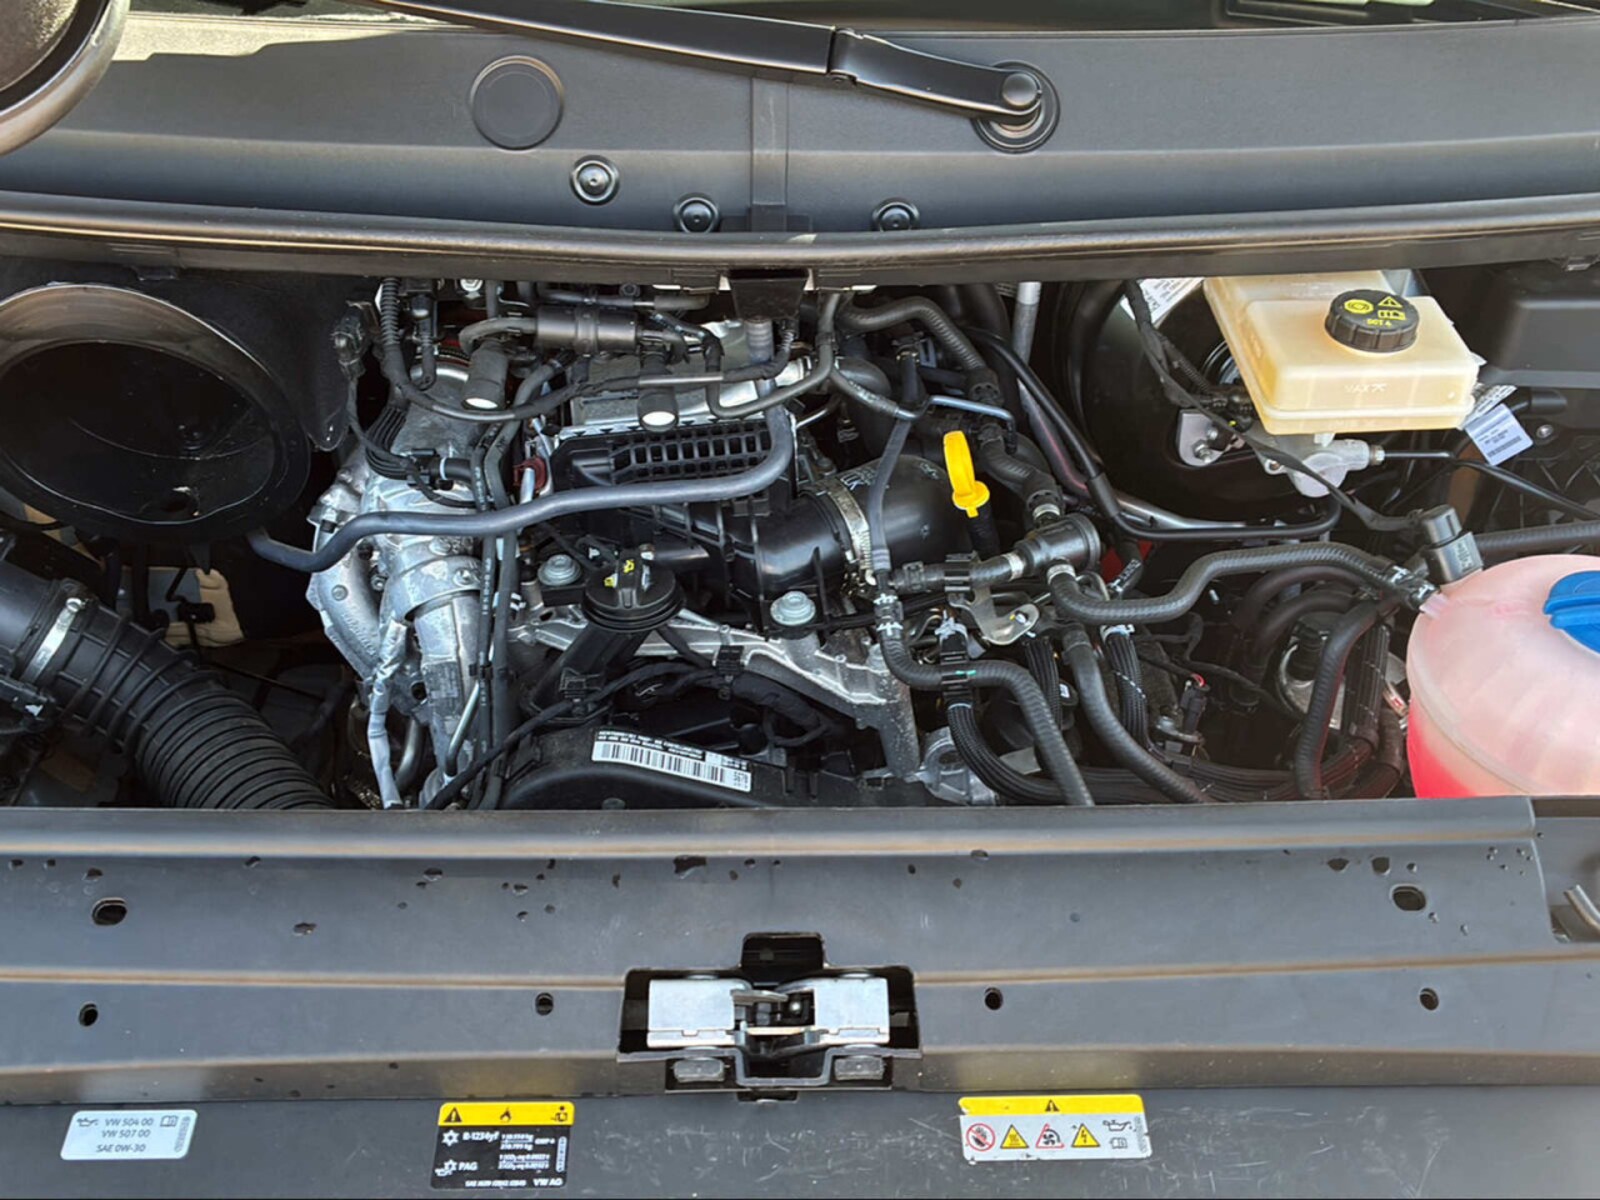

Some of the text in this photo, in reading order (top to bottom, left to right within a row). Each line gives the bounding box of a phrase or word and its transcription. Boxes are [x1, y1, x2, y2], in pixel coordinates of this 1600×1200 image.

[105, 1117, 154, 1126] VW 504 00
[102, 1129, 151, 1139] VW 507 00
[96, 1144, 146, 1152] SAE 0W-30
[458, 1161, 478, 1171] PAG
[532, 1178, 549, 1187] VW
[548, 1178, 563, 1187] AG
